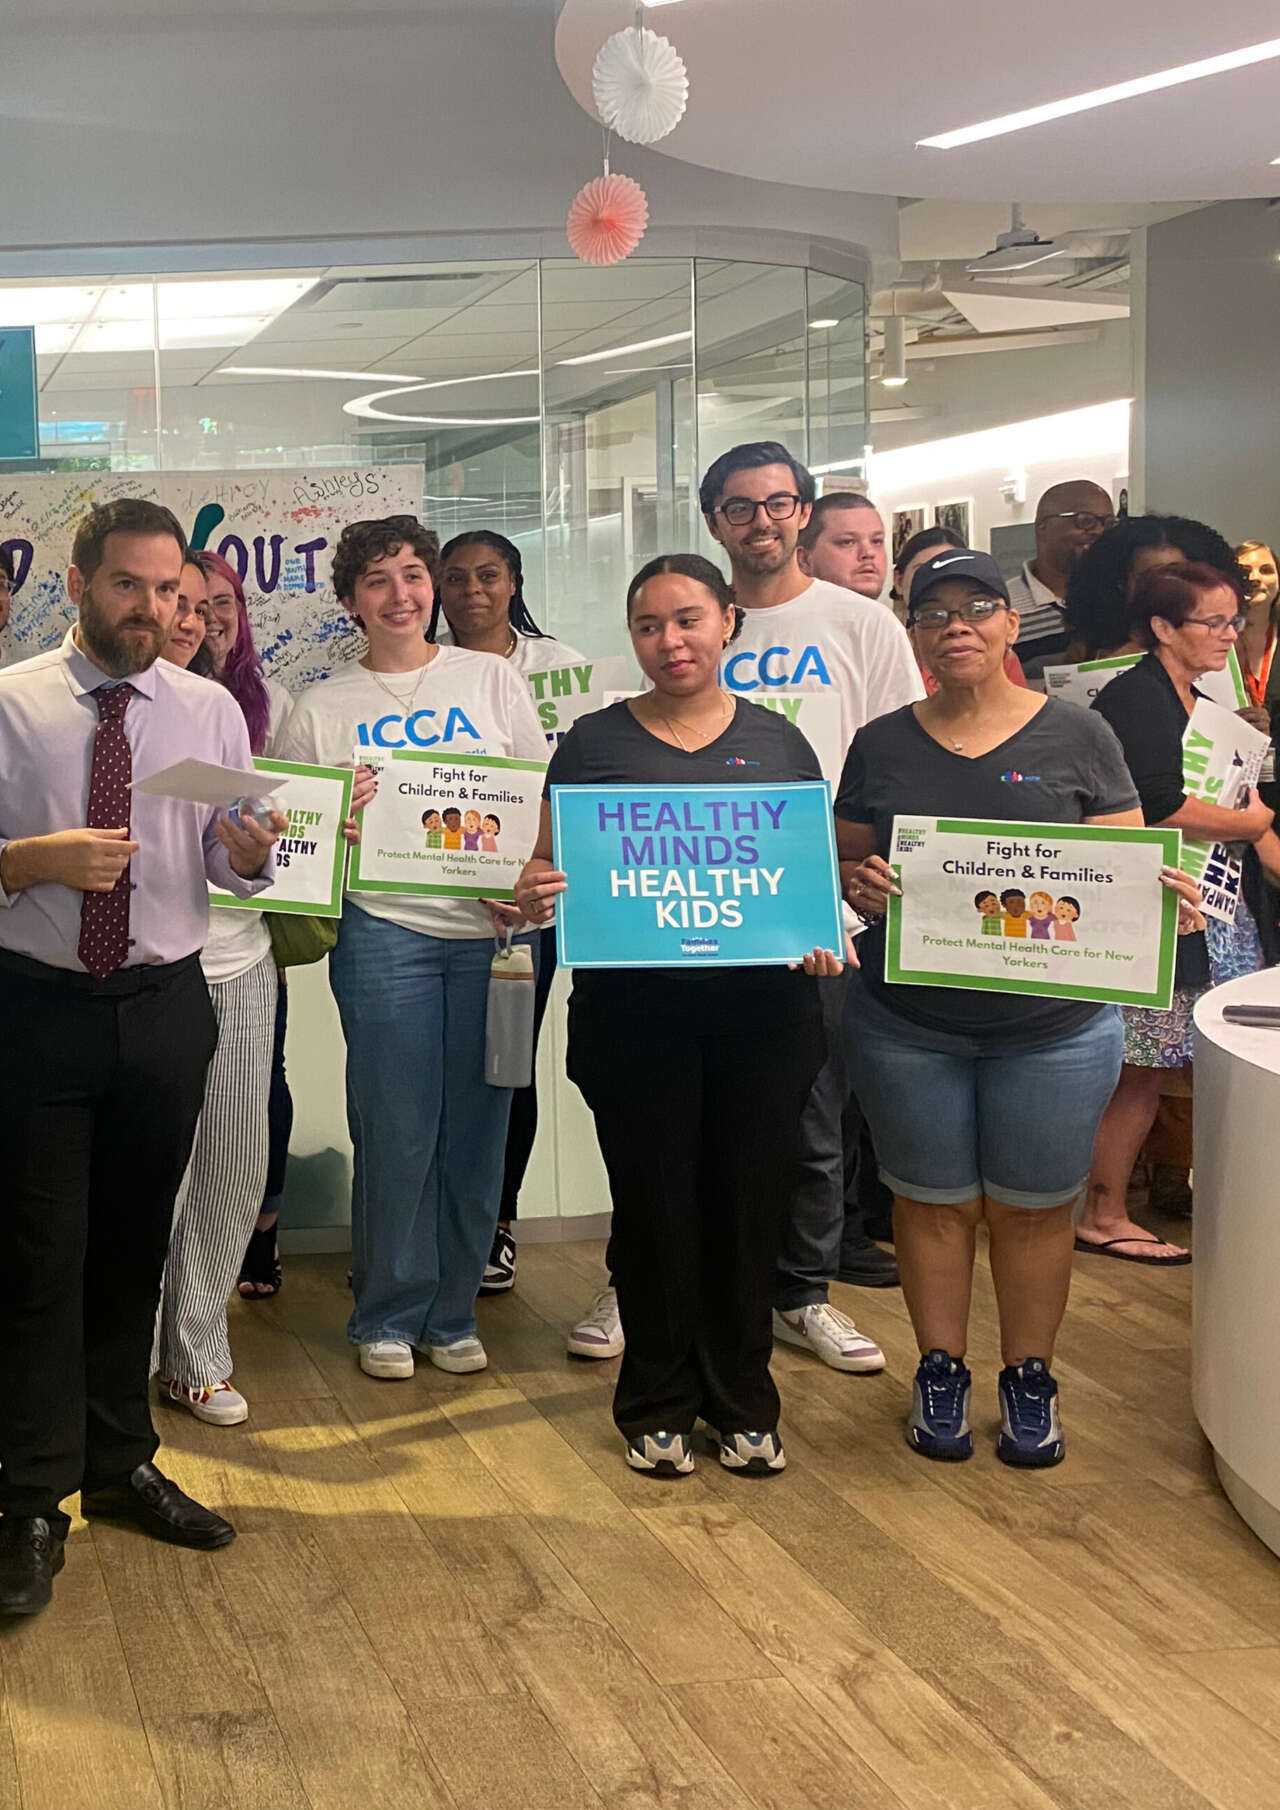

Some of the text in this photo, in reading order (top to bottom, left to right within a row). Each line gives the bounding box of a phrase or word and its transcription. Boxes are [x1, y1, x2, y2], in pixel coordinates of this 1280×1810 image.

[717, 646, 832, 692] CCA
[357, 707, 482, 748] ICCA
[433, 767, 488, 782] Fight for
[398, 783, 524, 804] Children & Families
[285, 809, 322, 826] ALTHY
[598, 800, 788, 832] HEALTHY
[277, 838, 317, 855] ALTHY
[621, 835, 760, 866] MINDS
[987, 841, 1062, 860] Fight for
[277, 853, 291, 867] DS
[377, 849, 516, 867] Protect Mental Health Care for
[441, 866, 477, 877] Yorkers
[610, 867, 785, 897] HEALTHY
[942, 860, 1113, 884] Children & Families
[656, 900, 744, 929] KIDS
[922, 935, 1134, 961] Protect Mental Health Care for New
[1002, 955, 1048, 969] Yorkers
